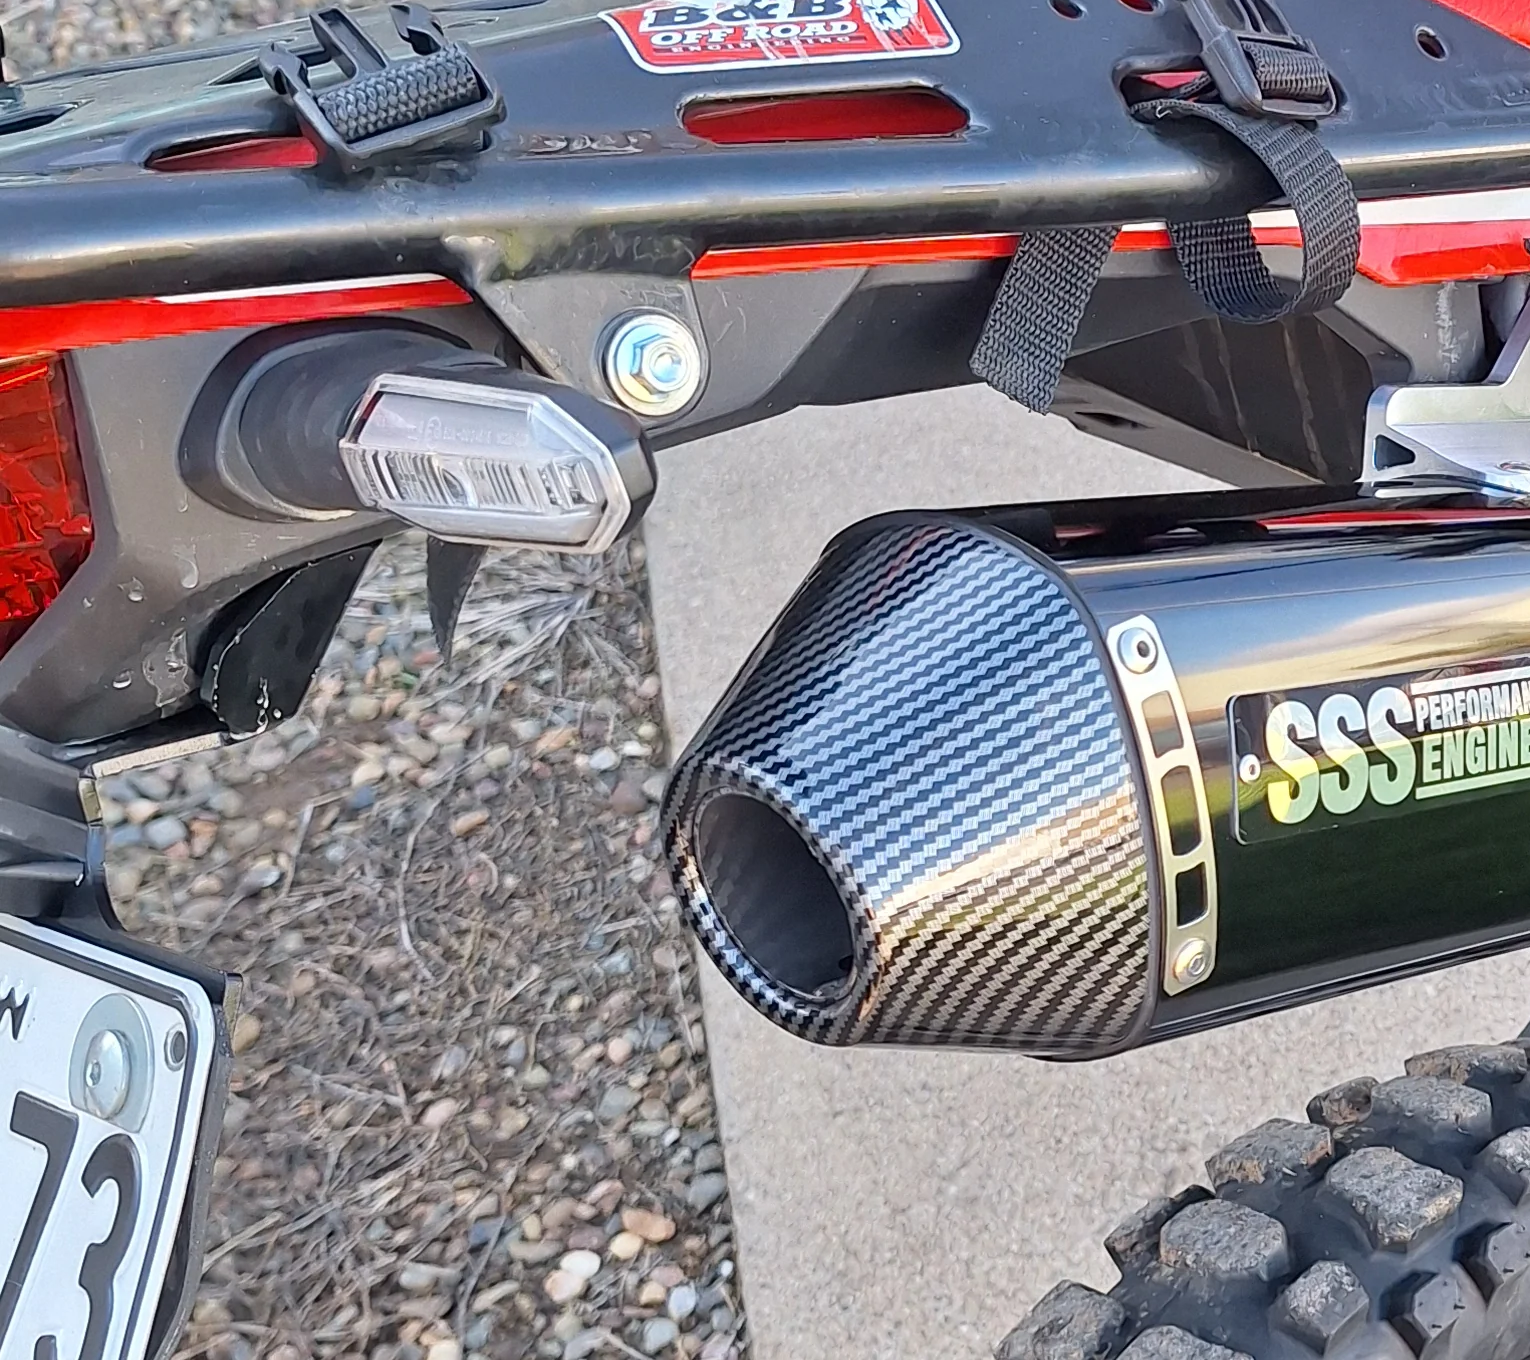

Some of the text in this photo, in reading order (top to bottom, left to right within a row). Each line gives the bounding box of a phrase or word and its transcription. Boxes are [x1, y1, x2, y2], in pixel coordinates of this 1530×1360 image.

[650, 20, 859, 47] OFF ROAD
[1265, 686, 1417, 825] SSS
